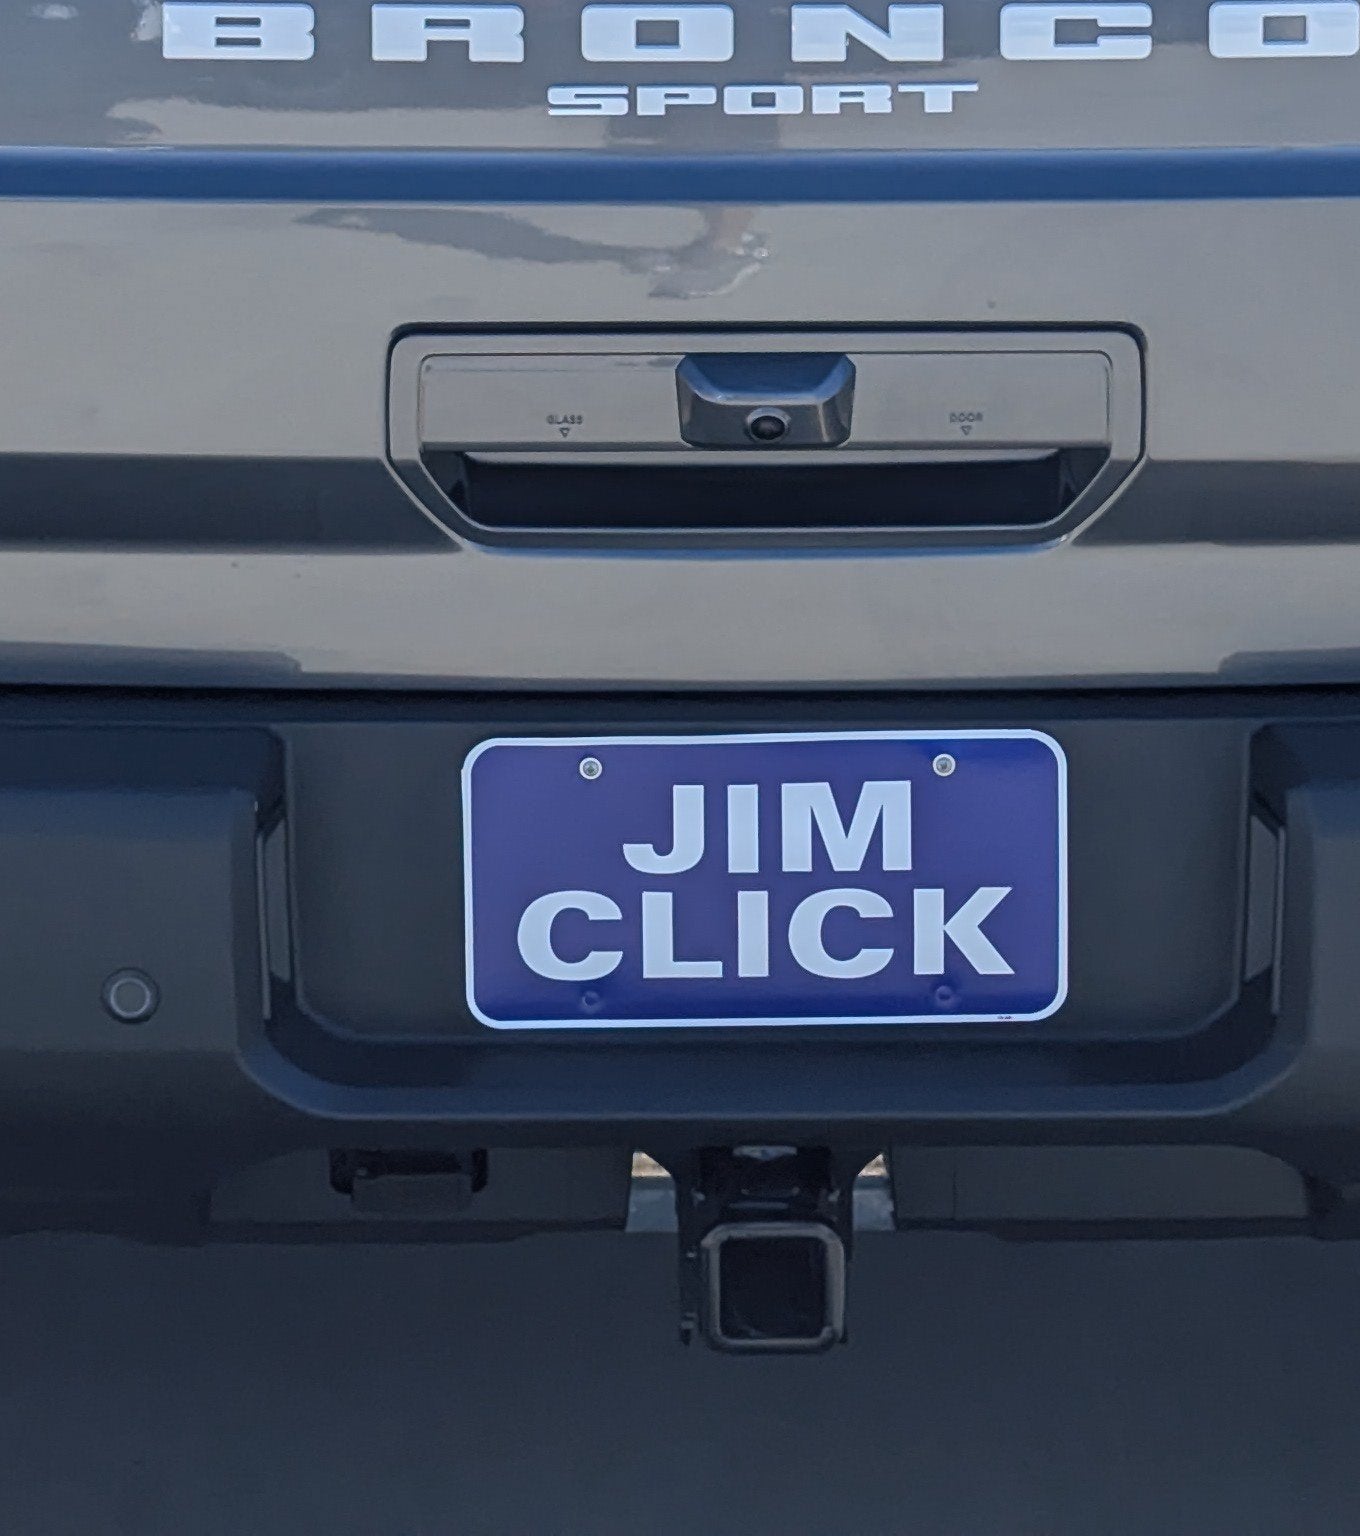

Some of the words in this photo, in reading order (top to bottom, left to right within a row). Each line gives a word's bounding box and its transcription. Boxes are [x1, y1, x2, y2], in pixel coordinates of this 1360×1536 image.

[161, 0, 1360, 62] BRONCO
[547, 81, 979, 118] SPORT
[546, 414, 583, 425] GLASS
[623, 780, 912, 874] JIM
[517, 886, 1015, 981] CLICK
